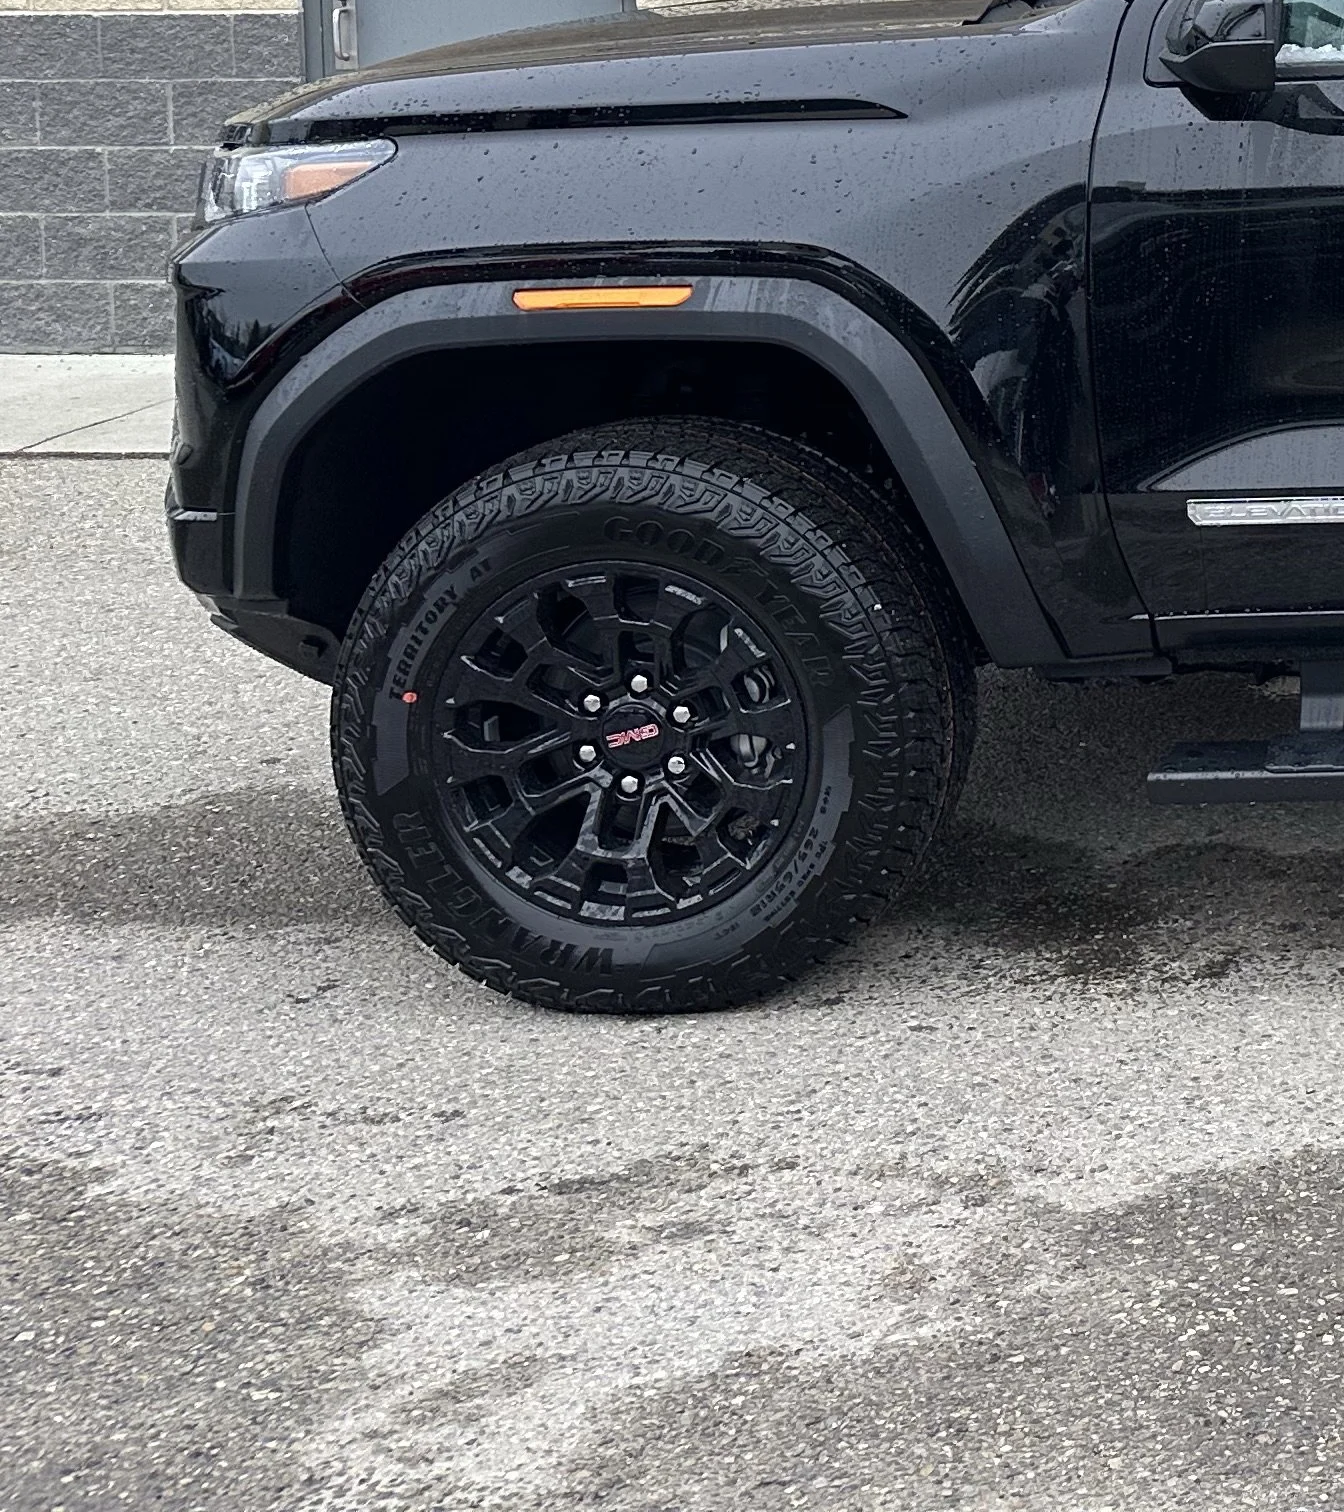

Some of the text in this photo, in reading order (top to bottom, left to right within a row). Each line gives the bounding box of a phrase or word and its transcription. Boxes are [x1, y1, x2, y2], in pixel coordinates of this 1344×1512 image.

[389, 558, 492, 700] TERRITORY AT
[606, 723, 659, 748] GMC
[392, 810, 615, 976] WRANGLER
